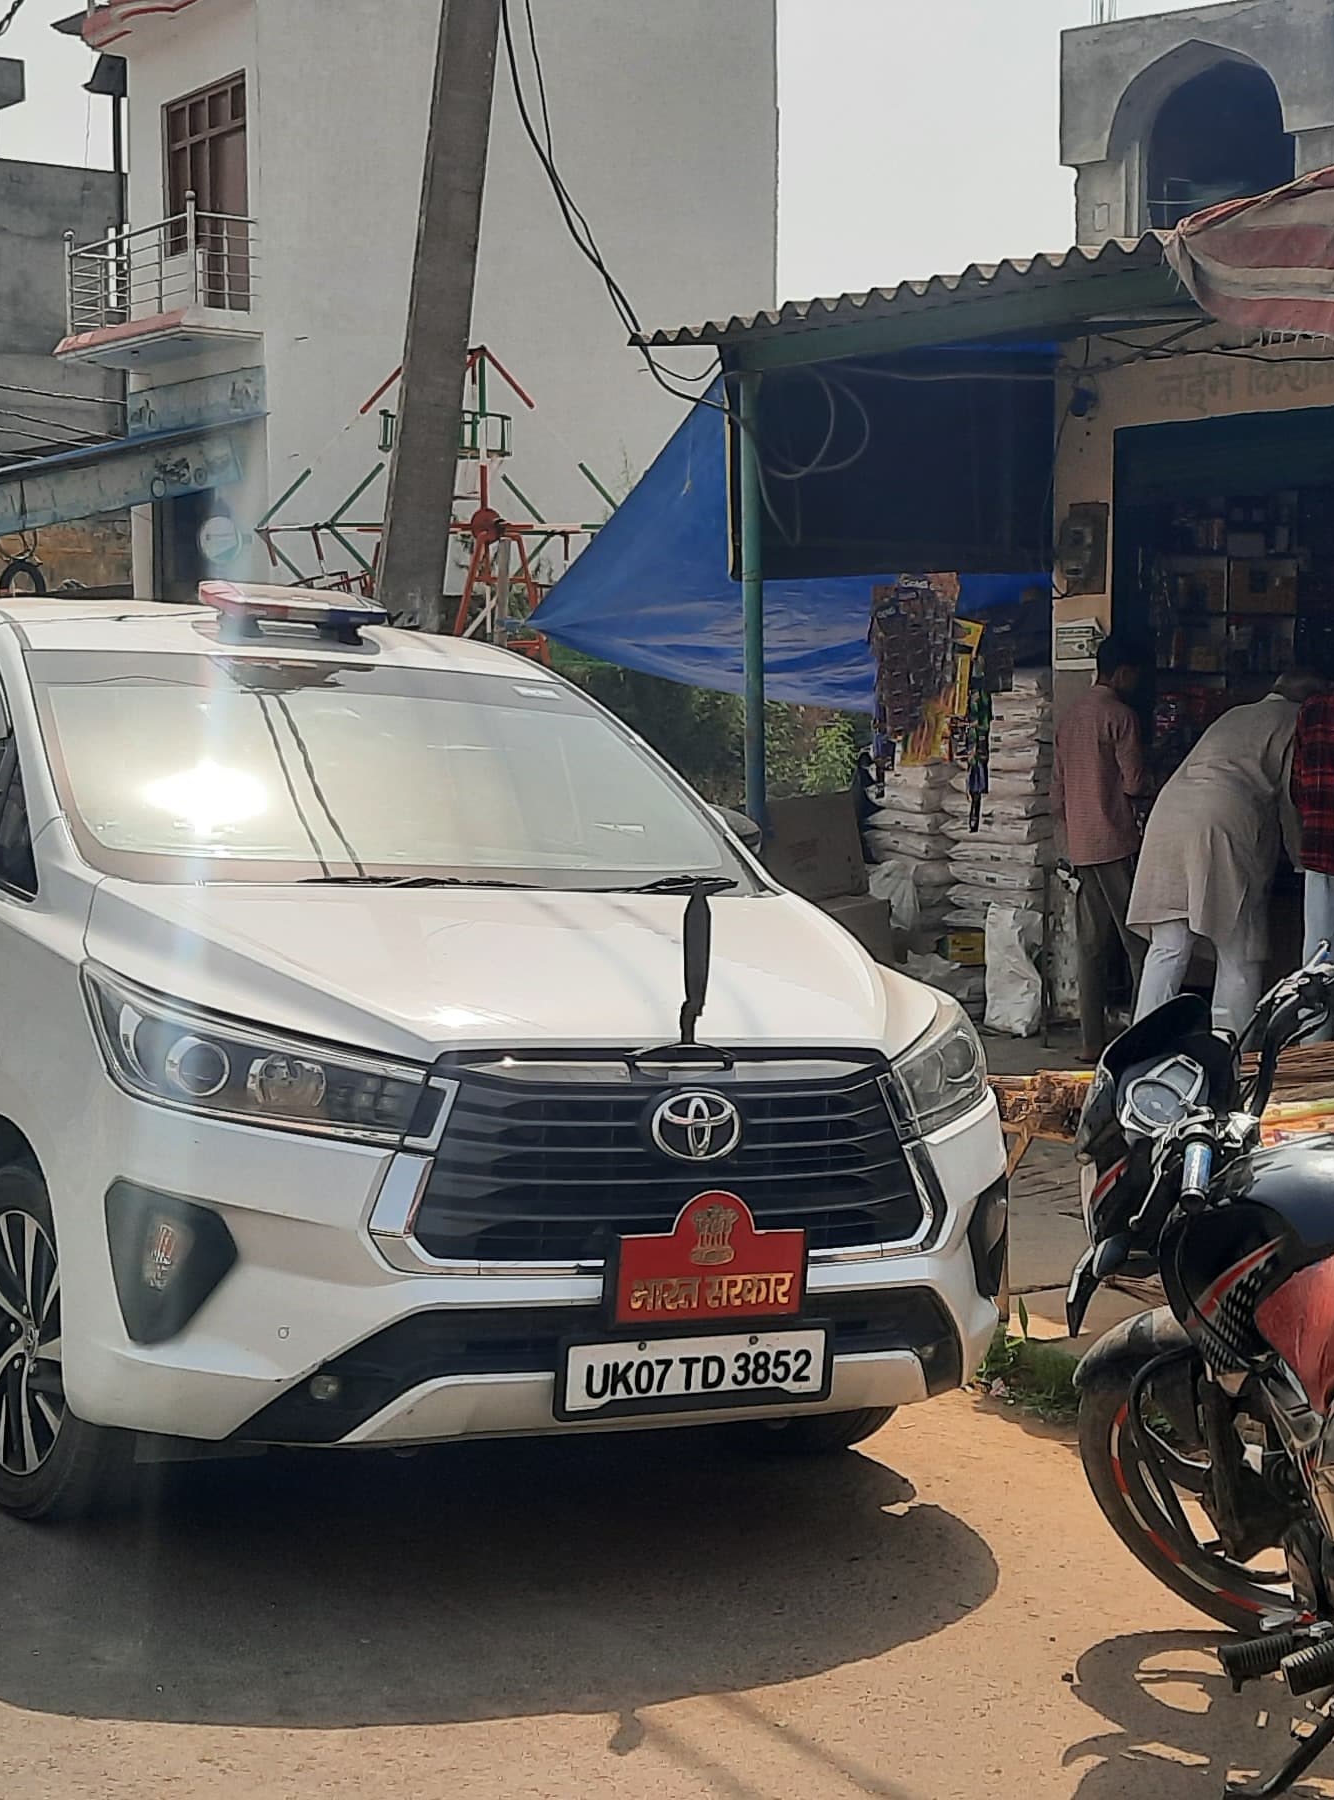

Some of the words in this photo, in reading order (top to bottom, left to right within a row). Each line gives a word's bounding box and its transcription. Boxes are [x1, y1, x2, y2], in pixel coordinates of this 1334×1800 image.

[630, 1276, 701, 1311] भारत
[705, 1272, 795, 1308] सरकार
[585, 1357, 673, 1400] UK07
[678, 1355, 726, 1392] TD
[731, 1348, 813, 1387] 3852
